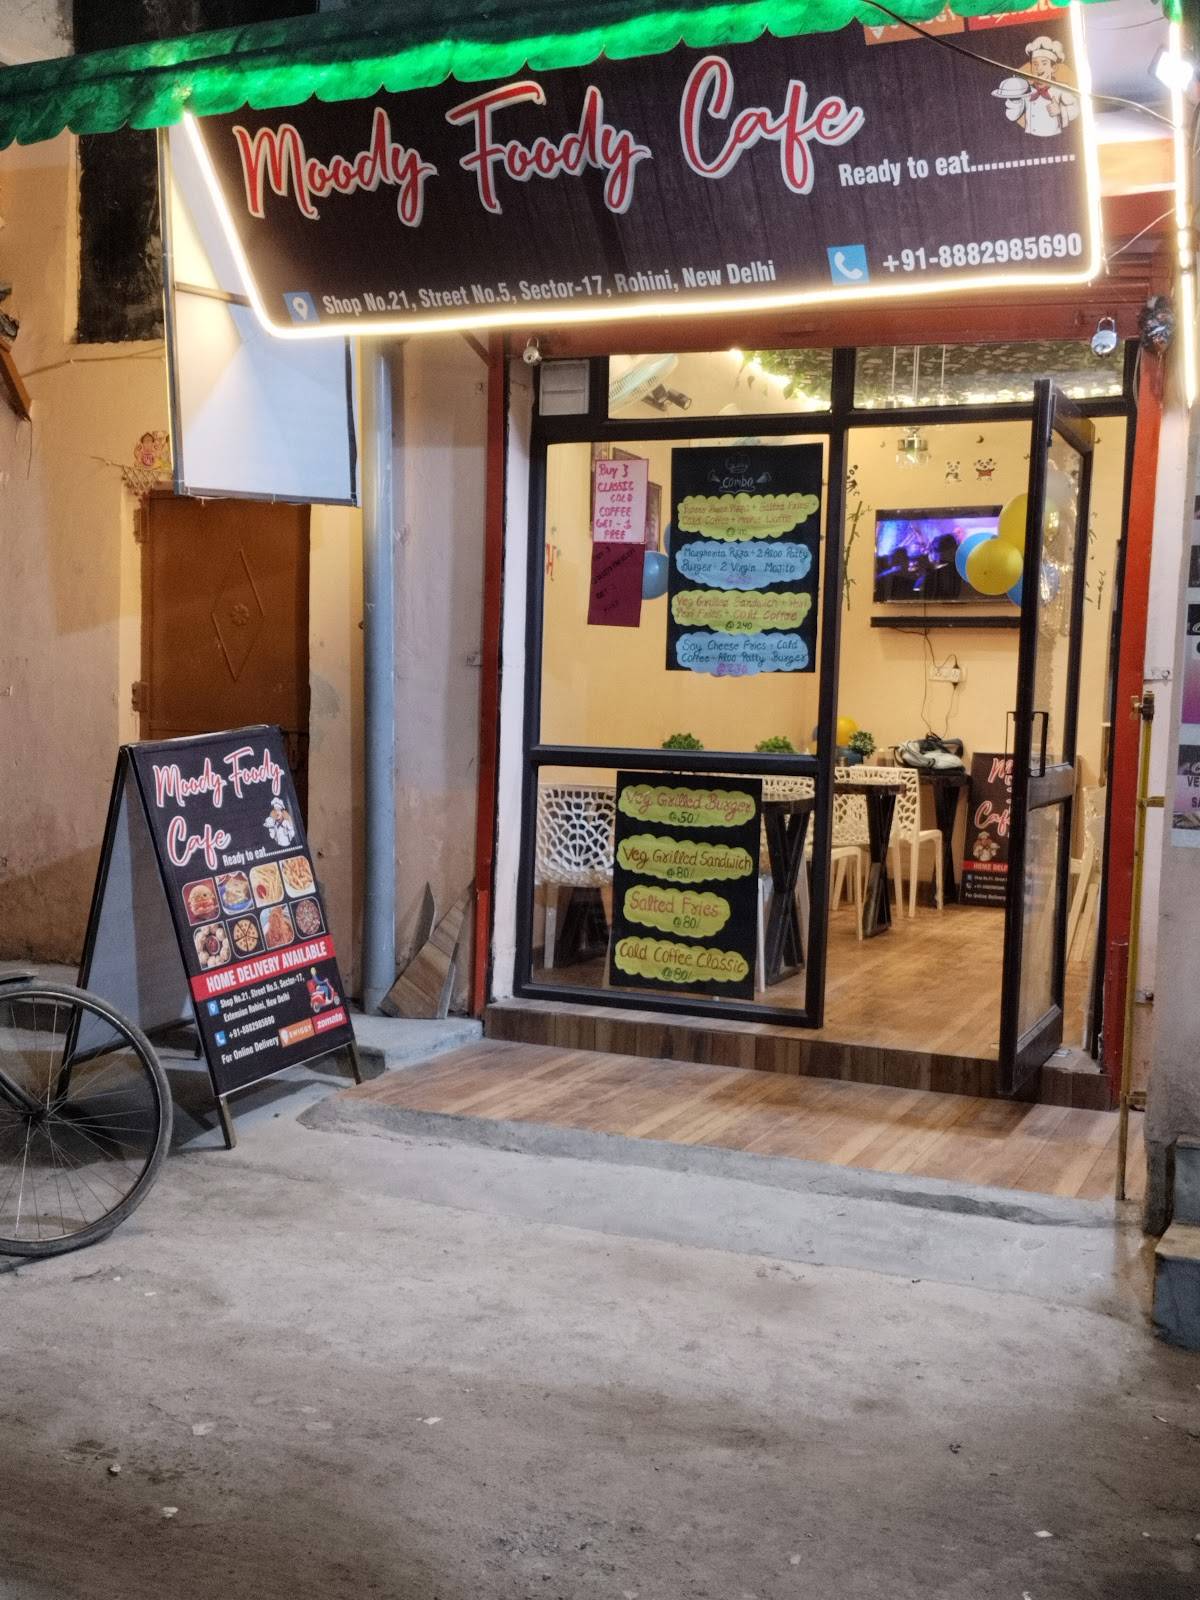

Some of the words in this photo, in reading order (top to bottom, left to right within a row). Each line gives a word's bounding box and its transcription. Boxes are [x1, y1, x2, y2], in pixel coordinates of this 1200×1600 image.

[232, 107, 437, 227] Moody
[445, 80, 653, 214] Foody
[680, 55, 865, 194] Cafe
[838, 159, 901, 187] Ready
[907, 157, 929, 179] to
[883, 233, 1083, 273] +91-8882985690
[322, 295, 363, 317] Shop
[363, 290, 417, 312] No.21,
[418, 286, 468, 308] Street
[471, 283, 517, 305] No.5,
[519, 275, 611, 300] Sector-17,
[614, 269, 679, 293] Rohini,
[682, 267, 722, 288] New
[726, 260, 777, 285] Delhi
[599, 464, 618, 479] Buy
[599, 506, 632, 518] COFFEE
[604, 530, 626, 540] FREE
[708, 640, 739, 651] Cheese
[152, 757, 228, 808] Moody
[224, 746, 285, 799] Foody
[657, 792, 701, 810] Grilled
[705, 793, 753, 822] Burger
[974, 800, 1011, 837] Caf
[167, 815, 231, 870] Cafe
[623, 845, 649, 869] Veg
[653, 849, 698, 867] Grilled
[700, 851, 752, 870] Sandwich
[222, 851, 245, 867] Ready
[245, 850, 254, 861] to
[630, 890, 675, 914] Salted
[681, 896, 719, 918] Fries
[206, 969, 236, 993] HOME
[236, 956, 280, 983] DELIVERY
[281, 941, 328, 969] AVAILABLE
[620, 942, 648, 961] Cold
[653, 947, 693, 967] Coffee
[696, 951, 745, 973] Classic
[220, 998, 234, 1009] Shop
[250, 986, 266, 998] Street
[223, 1007, 249, 1023] Extension
[266, 997, 278, 1008] New
[277, 991, 291, 1003] Delhi
[221, 1053, 233, 1065] For
[233, 1045, 255, 1060] Online
[254, 1035, 280, 1053] Delivery
